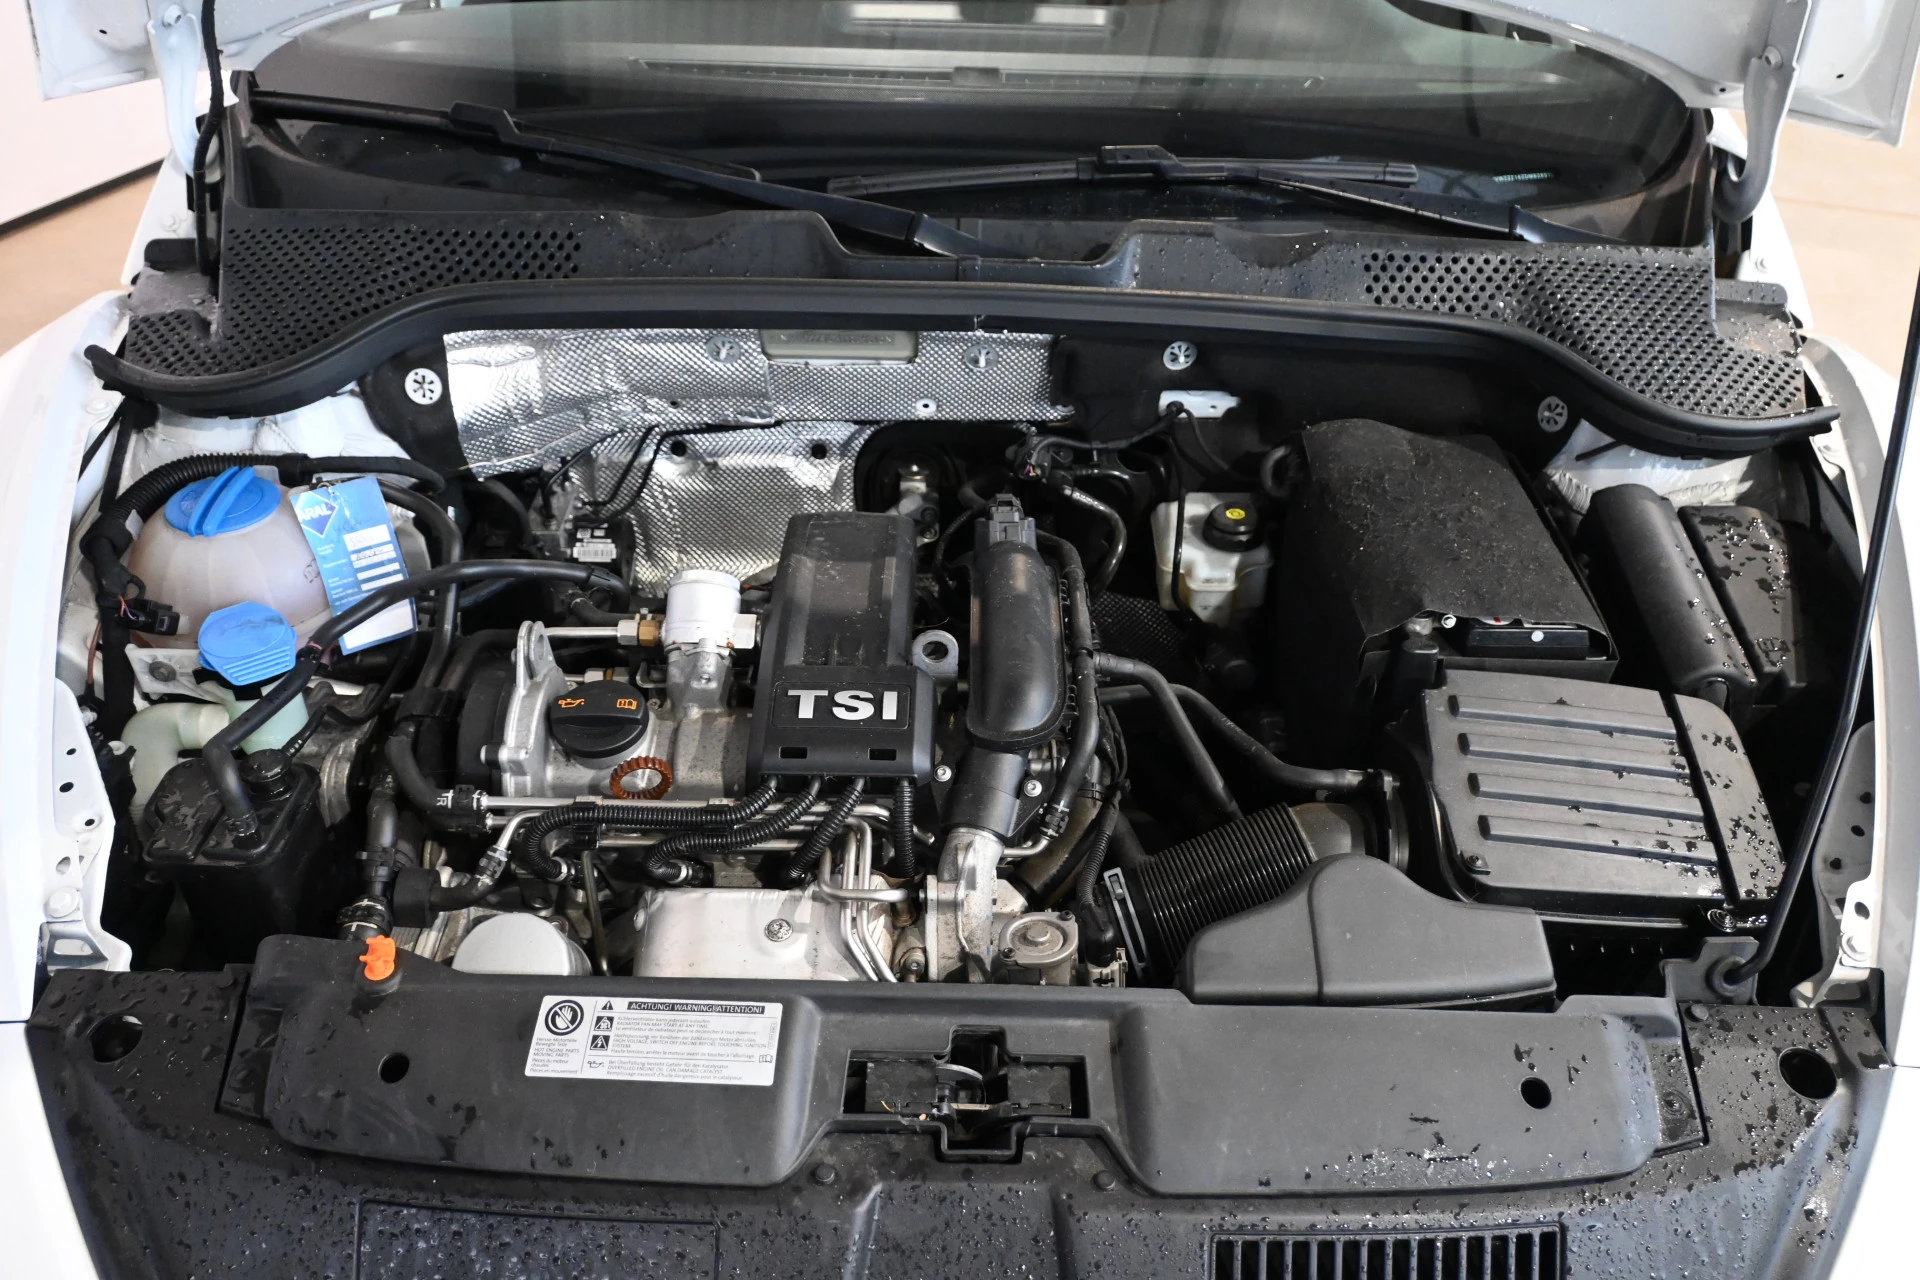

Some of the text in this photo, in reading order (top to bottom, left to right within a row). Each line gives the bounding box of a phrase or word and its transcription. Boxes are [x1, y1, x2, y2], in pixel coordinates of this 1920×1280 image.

[300, 504, 331, 521] ARAL
[787, 689, 898, 721] TSI
[630, 1002, 763, 1014] ACHTUNG! WARNING! ATTENTION!
